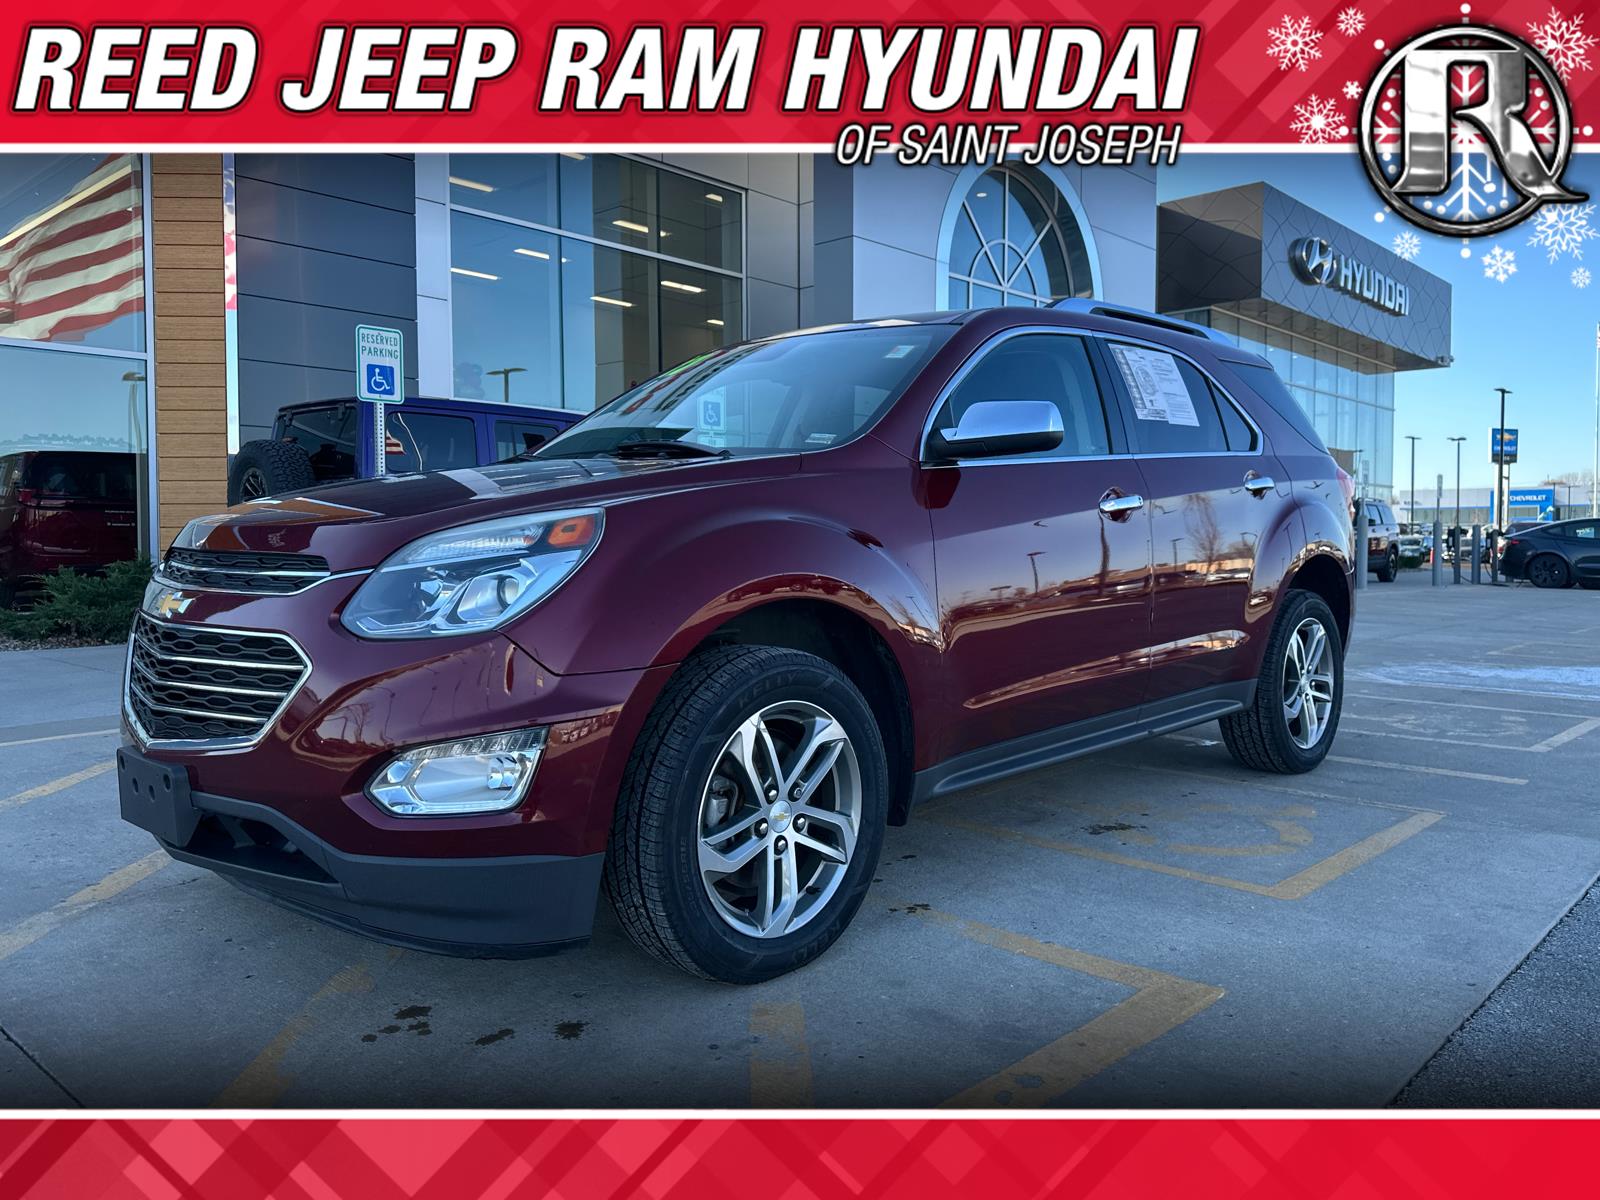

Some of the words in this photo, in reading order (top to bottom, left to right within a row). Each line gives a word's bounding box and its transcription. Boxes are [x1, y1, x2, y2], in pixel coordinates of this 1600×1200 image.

[1340, 253, 1409, 316] HYUNDAI
[361, 332, 398, 347] RESERVED
[361, 345, 399, 360] PARKING
[1509, 494, 1547, 502] CHEVROLET
